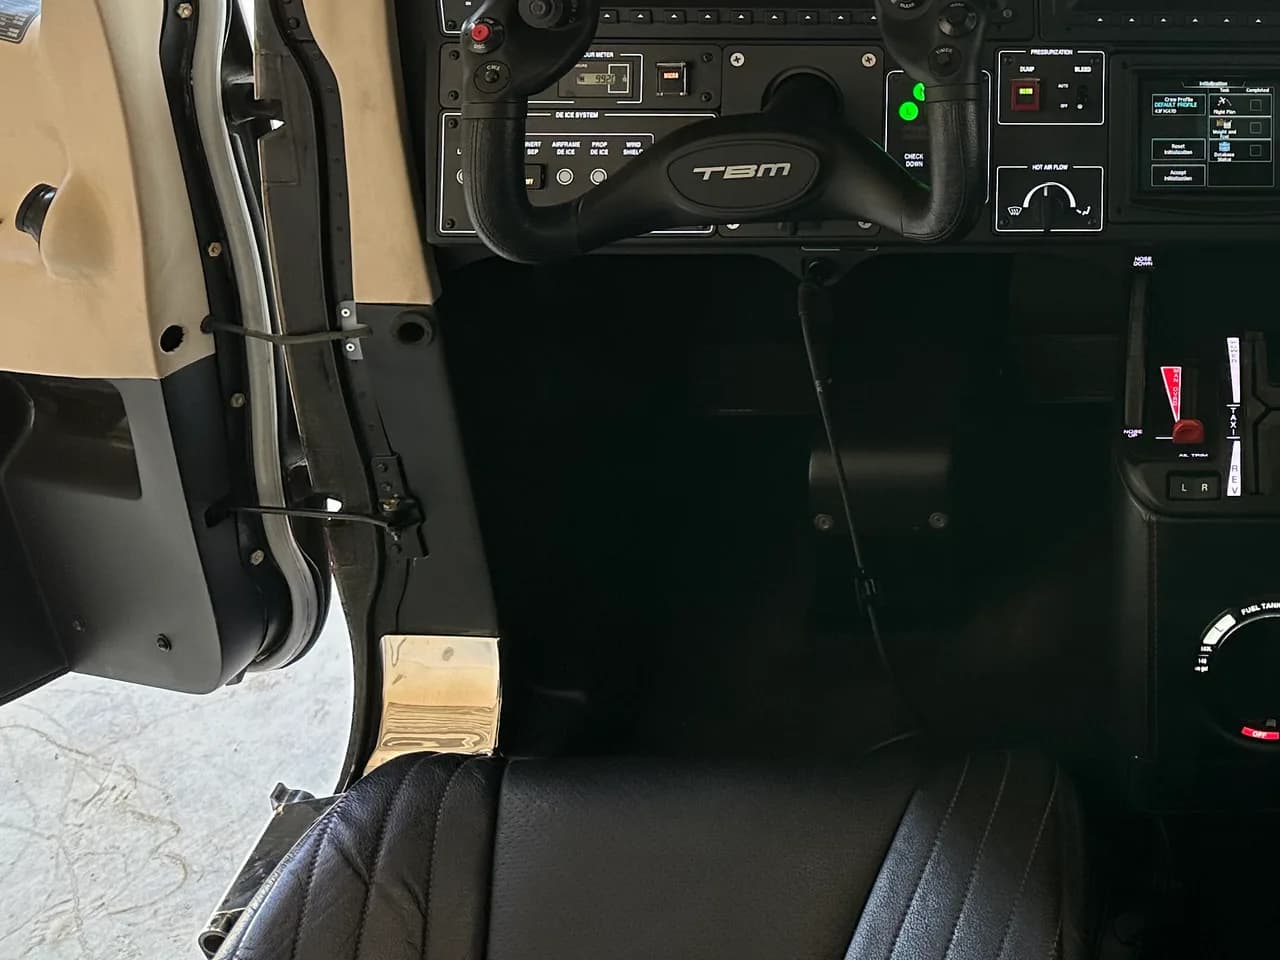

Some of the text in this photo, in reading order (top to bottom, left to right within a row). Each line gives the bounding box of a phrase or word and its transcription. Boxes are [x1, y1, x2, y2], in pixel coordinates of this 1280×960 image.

[693, 163, 791, 181] TBM
[1229, 407, 1237, 435] TAXI
[1181, 483, 1208, 492] L R
[1241, 605, 1261, 615] FUEL
[1215, 625, 1224, 633] L
